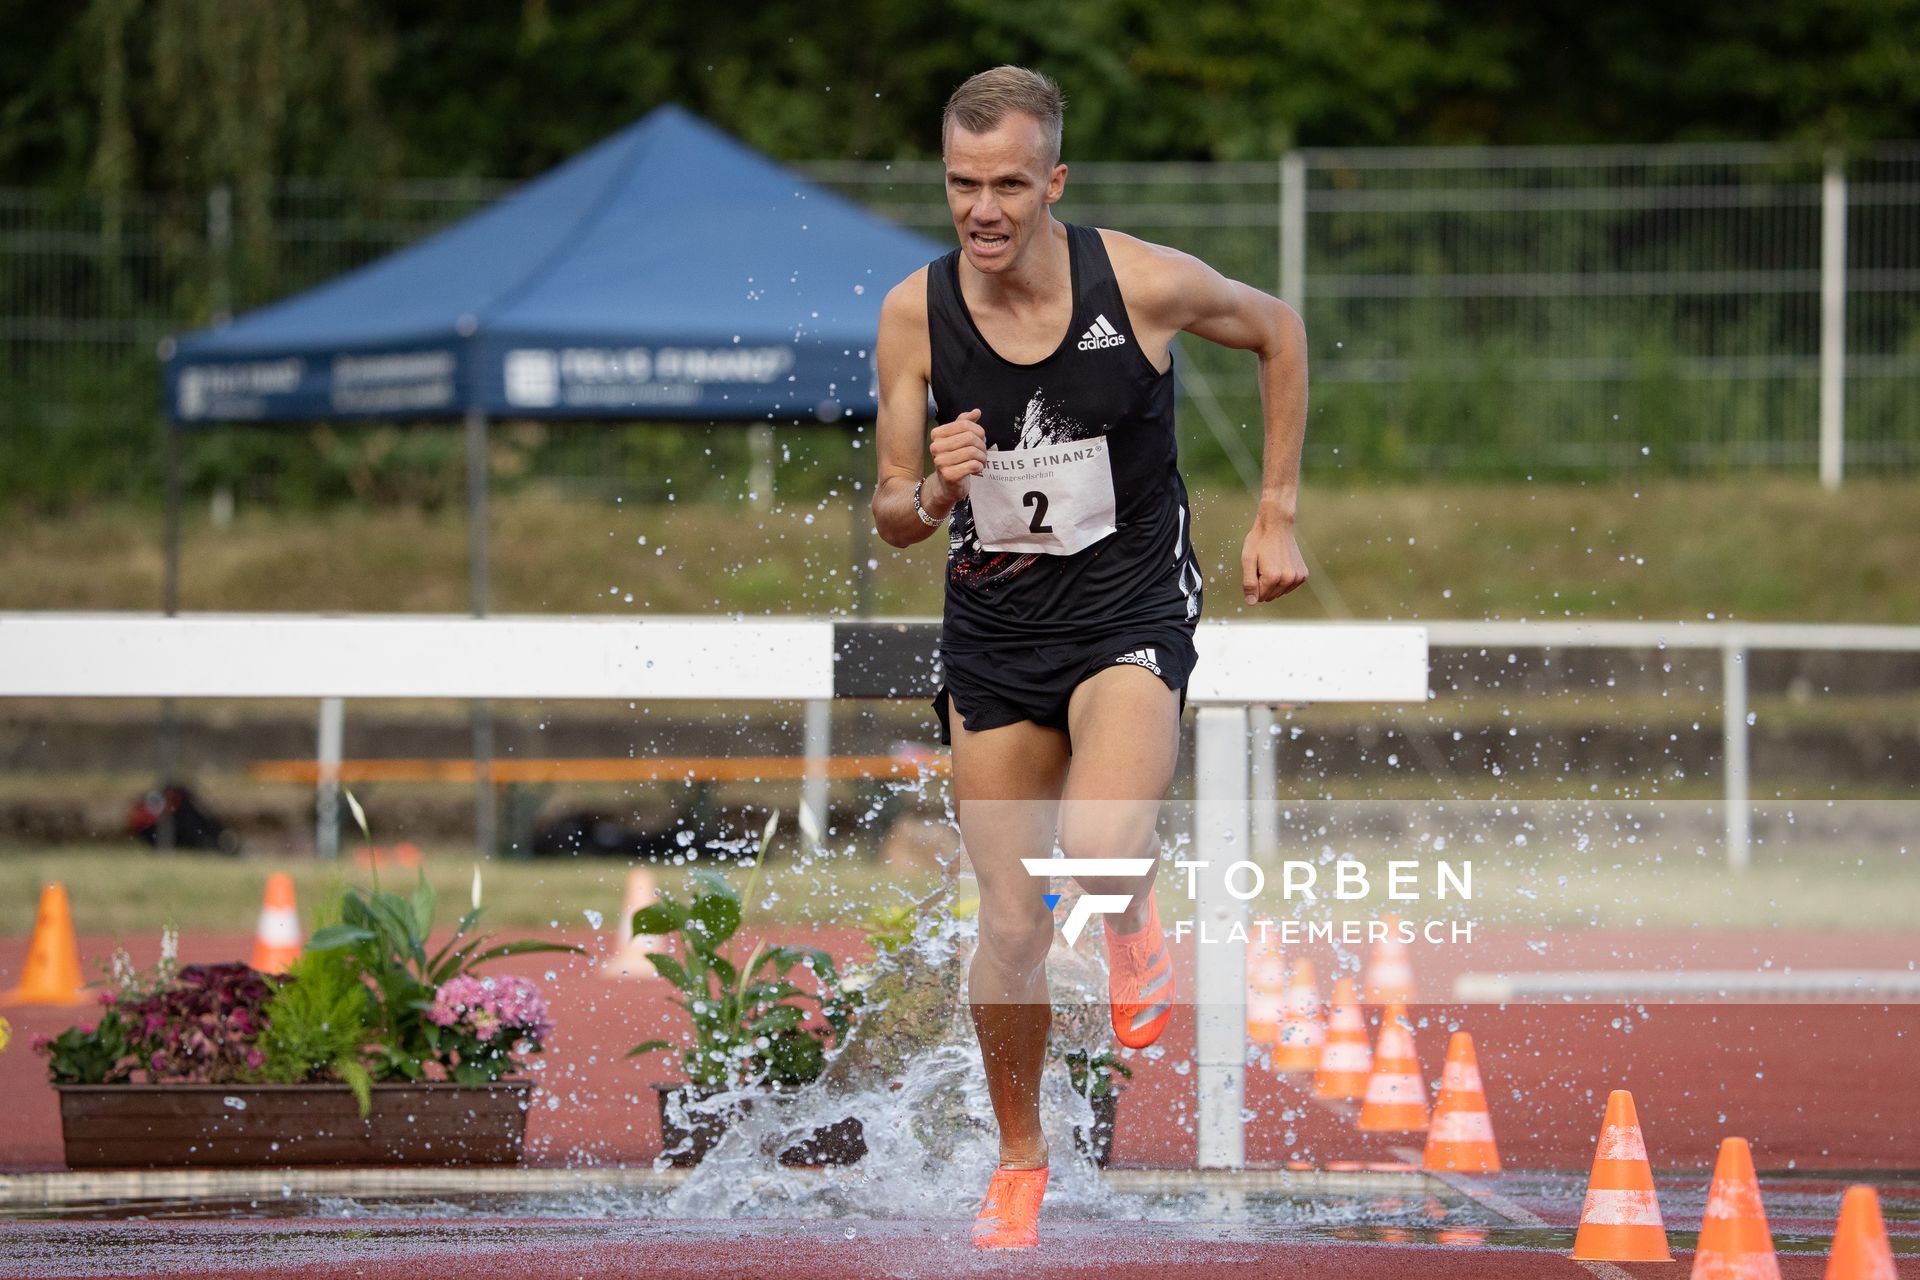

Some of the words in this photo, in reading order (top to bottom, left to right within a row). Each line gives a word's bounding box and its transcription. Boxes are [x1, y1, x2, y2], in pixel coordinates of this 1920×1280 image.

[1077, 334, 1126, 351] adidas
[1022, 490, 1053, 534] 2
[1115, 655, 1162, 676] adidas
